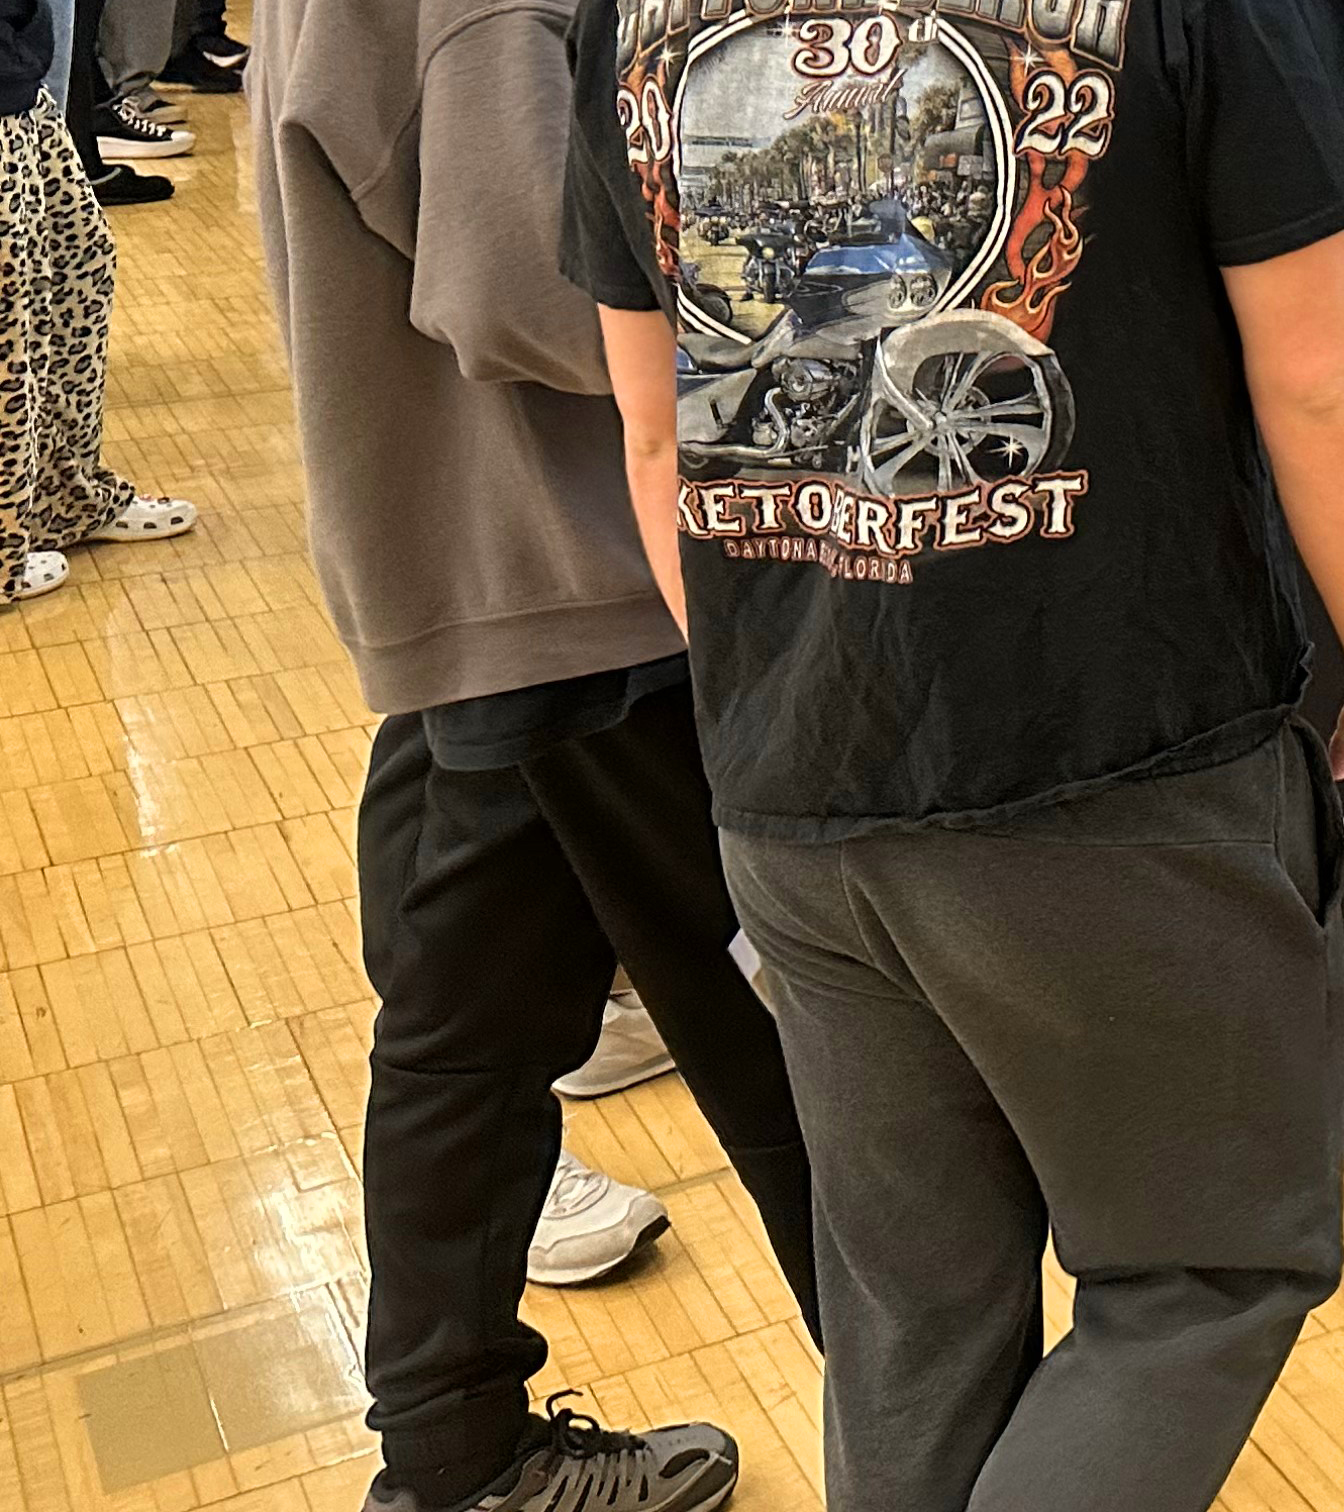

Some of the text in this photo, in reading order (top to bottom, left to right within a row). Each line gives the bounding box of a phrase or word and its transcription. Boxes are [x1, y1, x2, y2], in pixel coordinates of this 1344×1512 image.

[616, 75, 675, 167] 20
[1015, 68, 1115, 161] 22
[725, 536, 818, 563] DAYTONA
